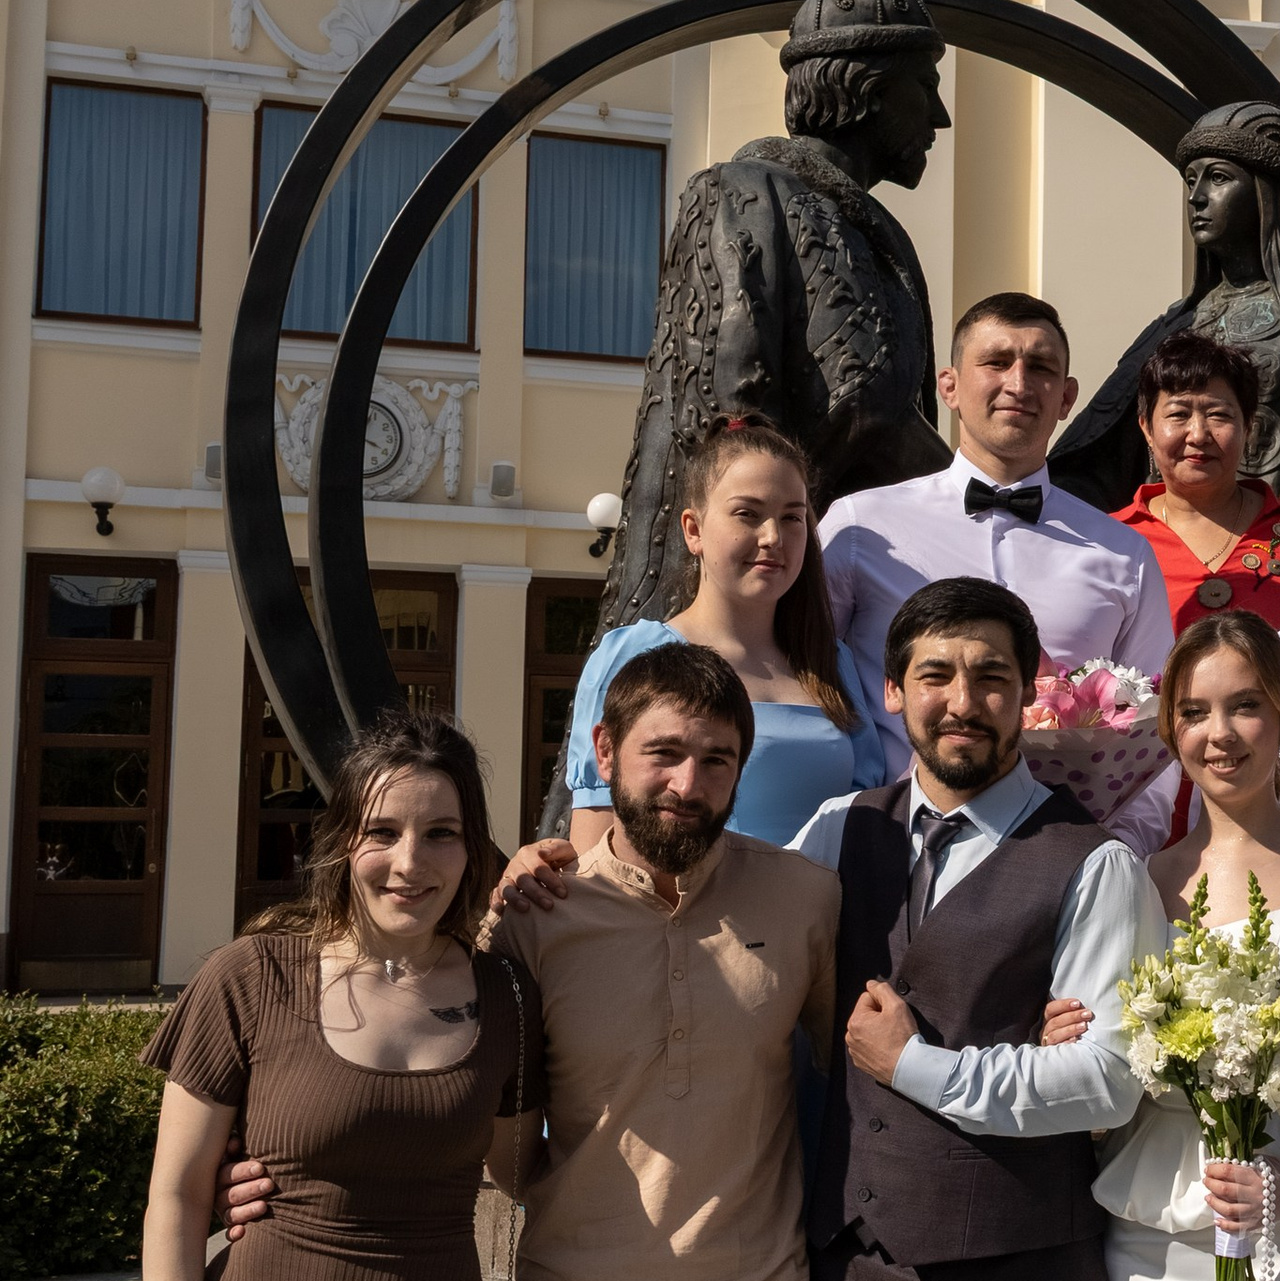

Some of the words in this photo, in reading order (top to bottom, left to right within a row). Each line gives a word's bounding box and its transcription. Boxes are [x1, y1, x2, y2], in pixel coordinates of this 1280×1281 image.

[382, 423, 389, 432] 2
[386, 435, 393, 444] 3
[381, 448, 388, 456] 4
[371, 457, 378, 465] 5
